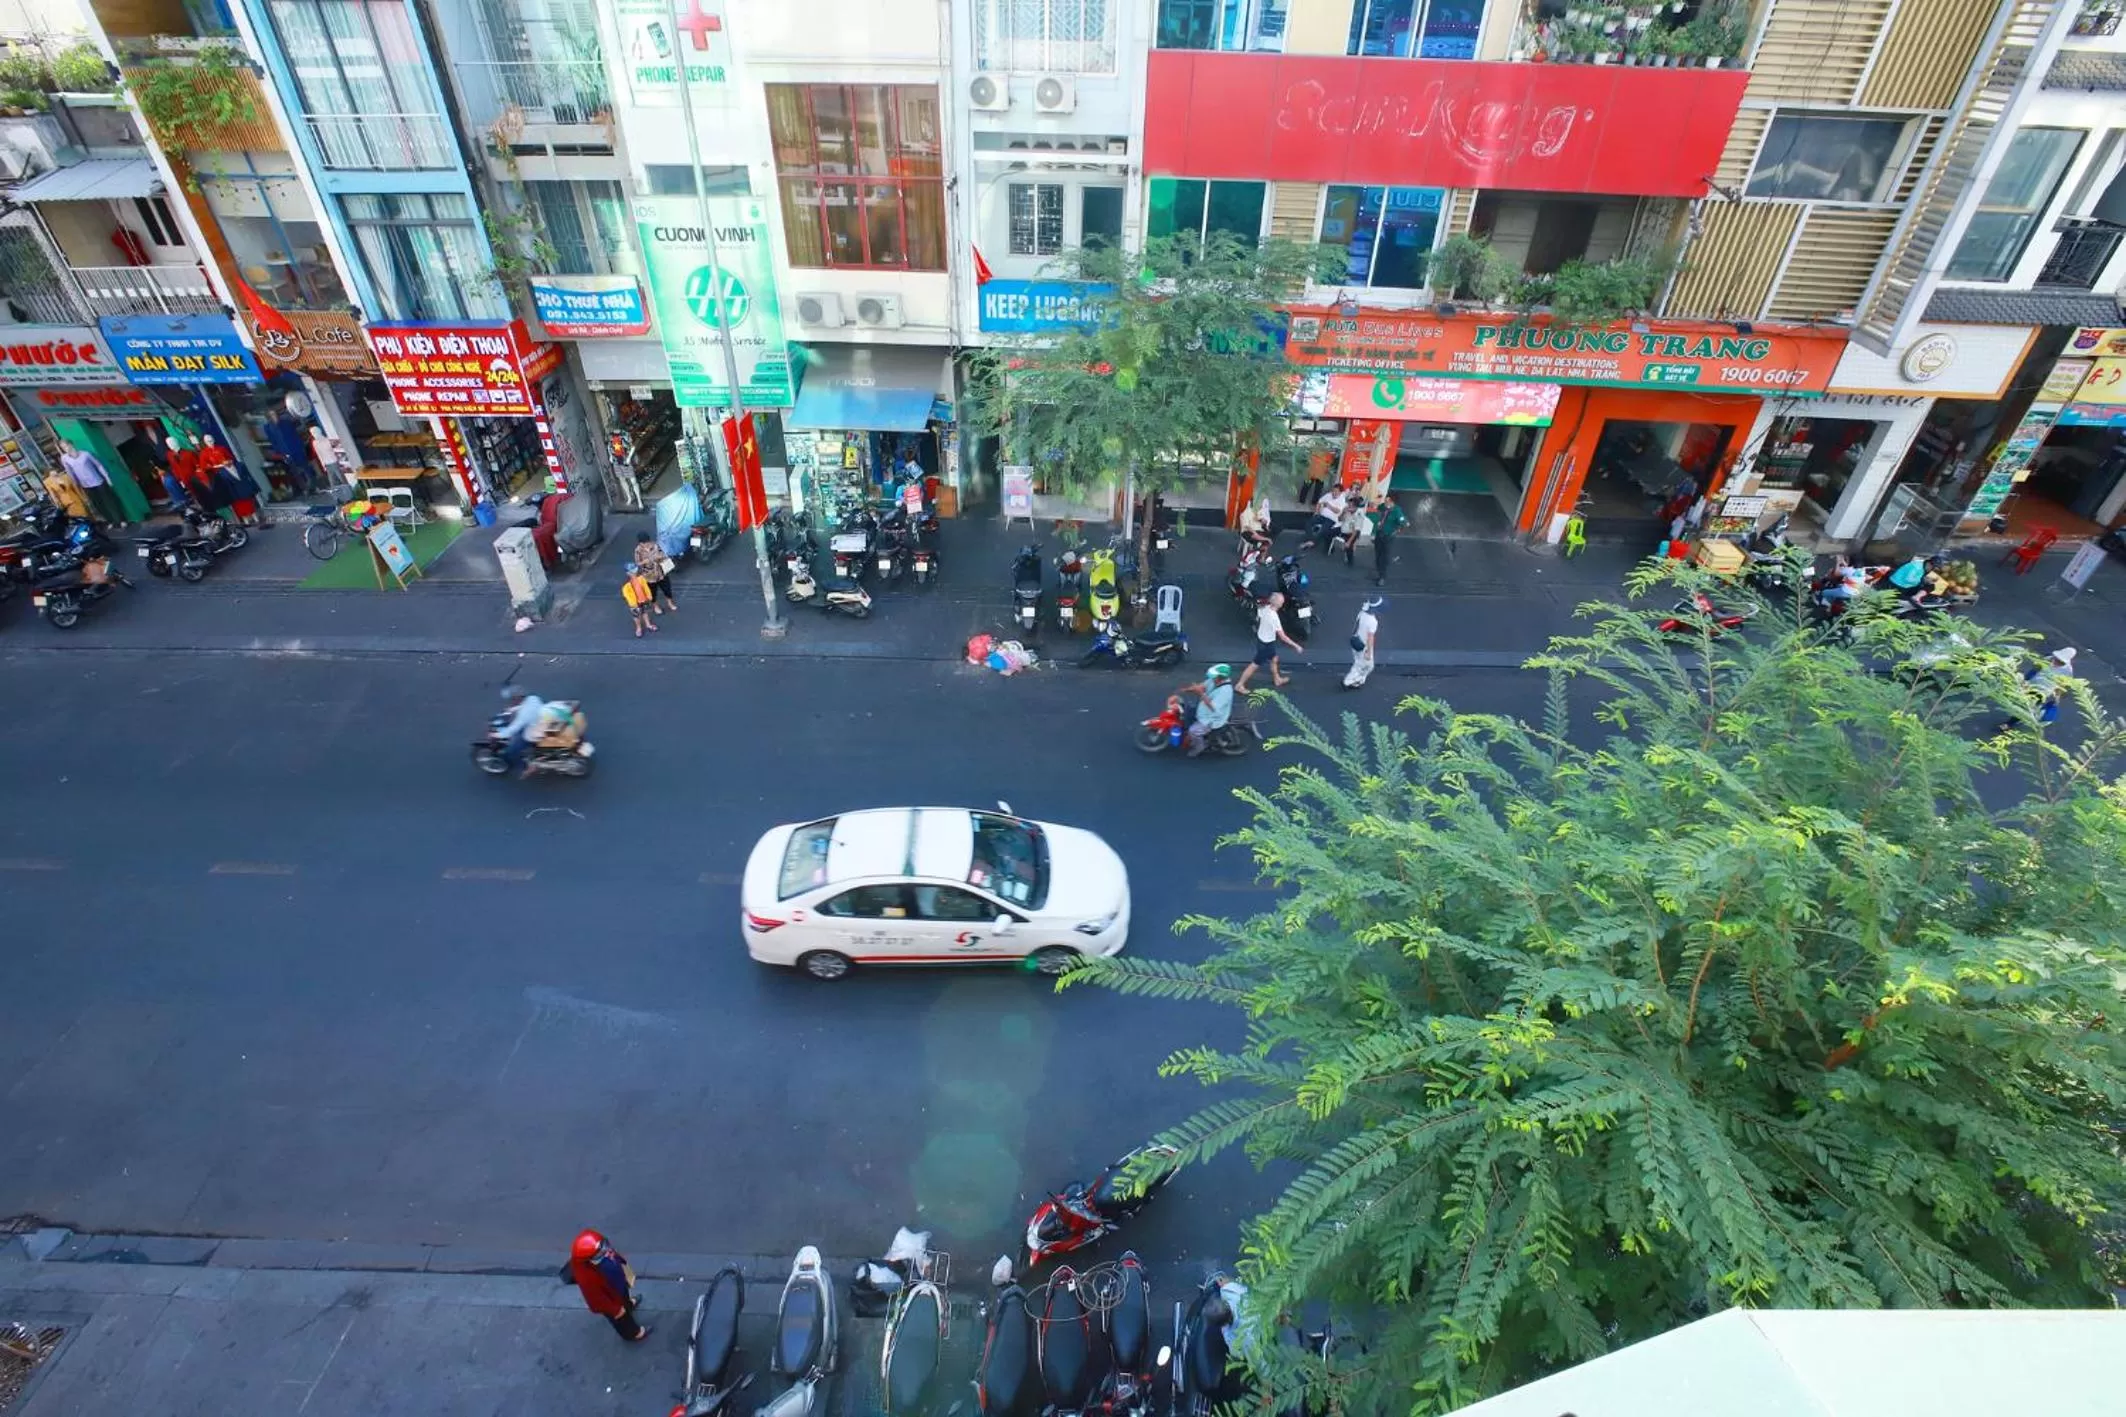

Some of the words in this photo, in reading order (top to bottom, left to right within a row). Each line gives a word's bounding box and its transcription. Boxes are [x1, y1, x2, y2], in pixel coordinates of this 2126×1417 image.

[714, 227, 756, 242] VINH
[985, 292, 1030, 320] KEEP
[312, 326, 353, 343] Cafe
[1397, 322, 1444, 338] Lines
[374, 336, 403, 358] PHỤ
[405, 333, 436, 358] KIỆN
[438, 333, 470, 358] ĐIỆN
[469, 335, 510, 359] THOẠI
[1638, 333, 1772, 362] TRANG
[172, 354, 206, 372] ĐẠT
[209, 354, 246, 370] SILK
[1327, 357, 1372, 368] TICKETING
[1374, 359, 1406, 370] OFFICE
[1452, 351, 1486, 362] TRAVEL
[1489, 354, 1508, 364] AND
[1511, 354, 1553, 367] VACATION
[1554, 357, 1620, 370] DESTINATIONS
[1530, 366, 1544, 376] DA
[1567, 367, 1588, 378] NHA
[1590, 368, 1622, 380] TRANG
[1720, 366, 1762, 383] 1900
[1763, 368, 1810, 385] 6067
[388, 377, 419, 388] PHONE
[423, 377, 484, 388] ACCESSORIES
[402, 391, 433, 402] PHONE
[1407, 389, 1435, 401] 1900
